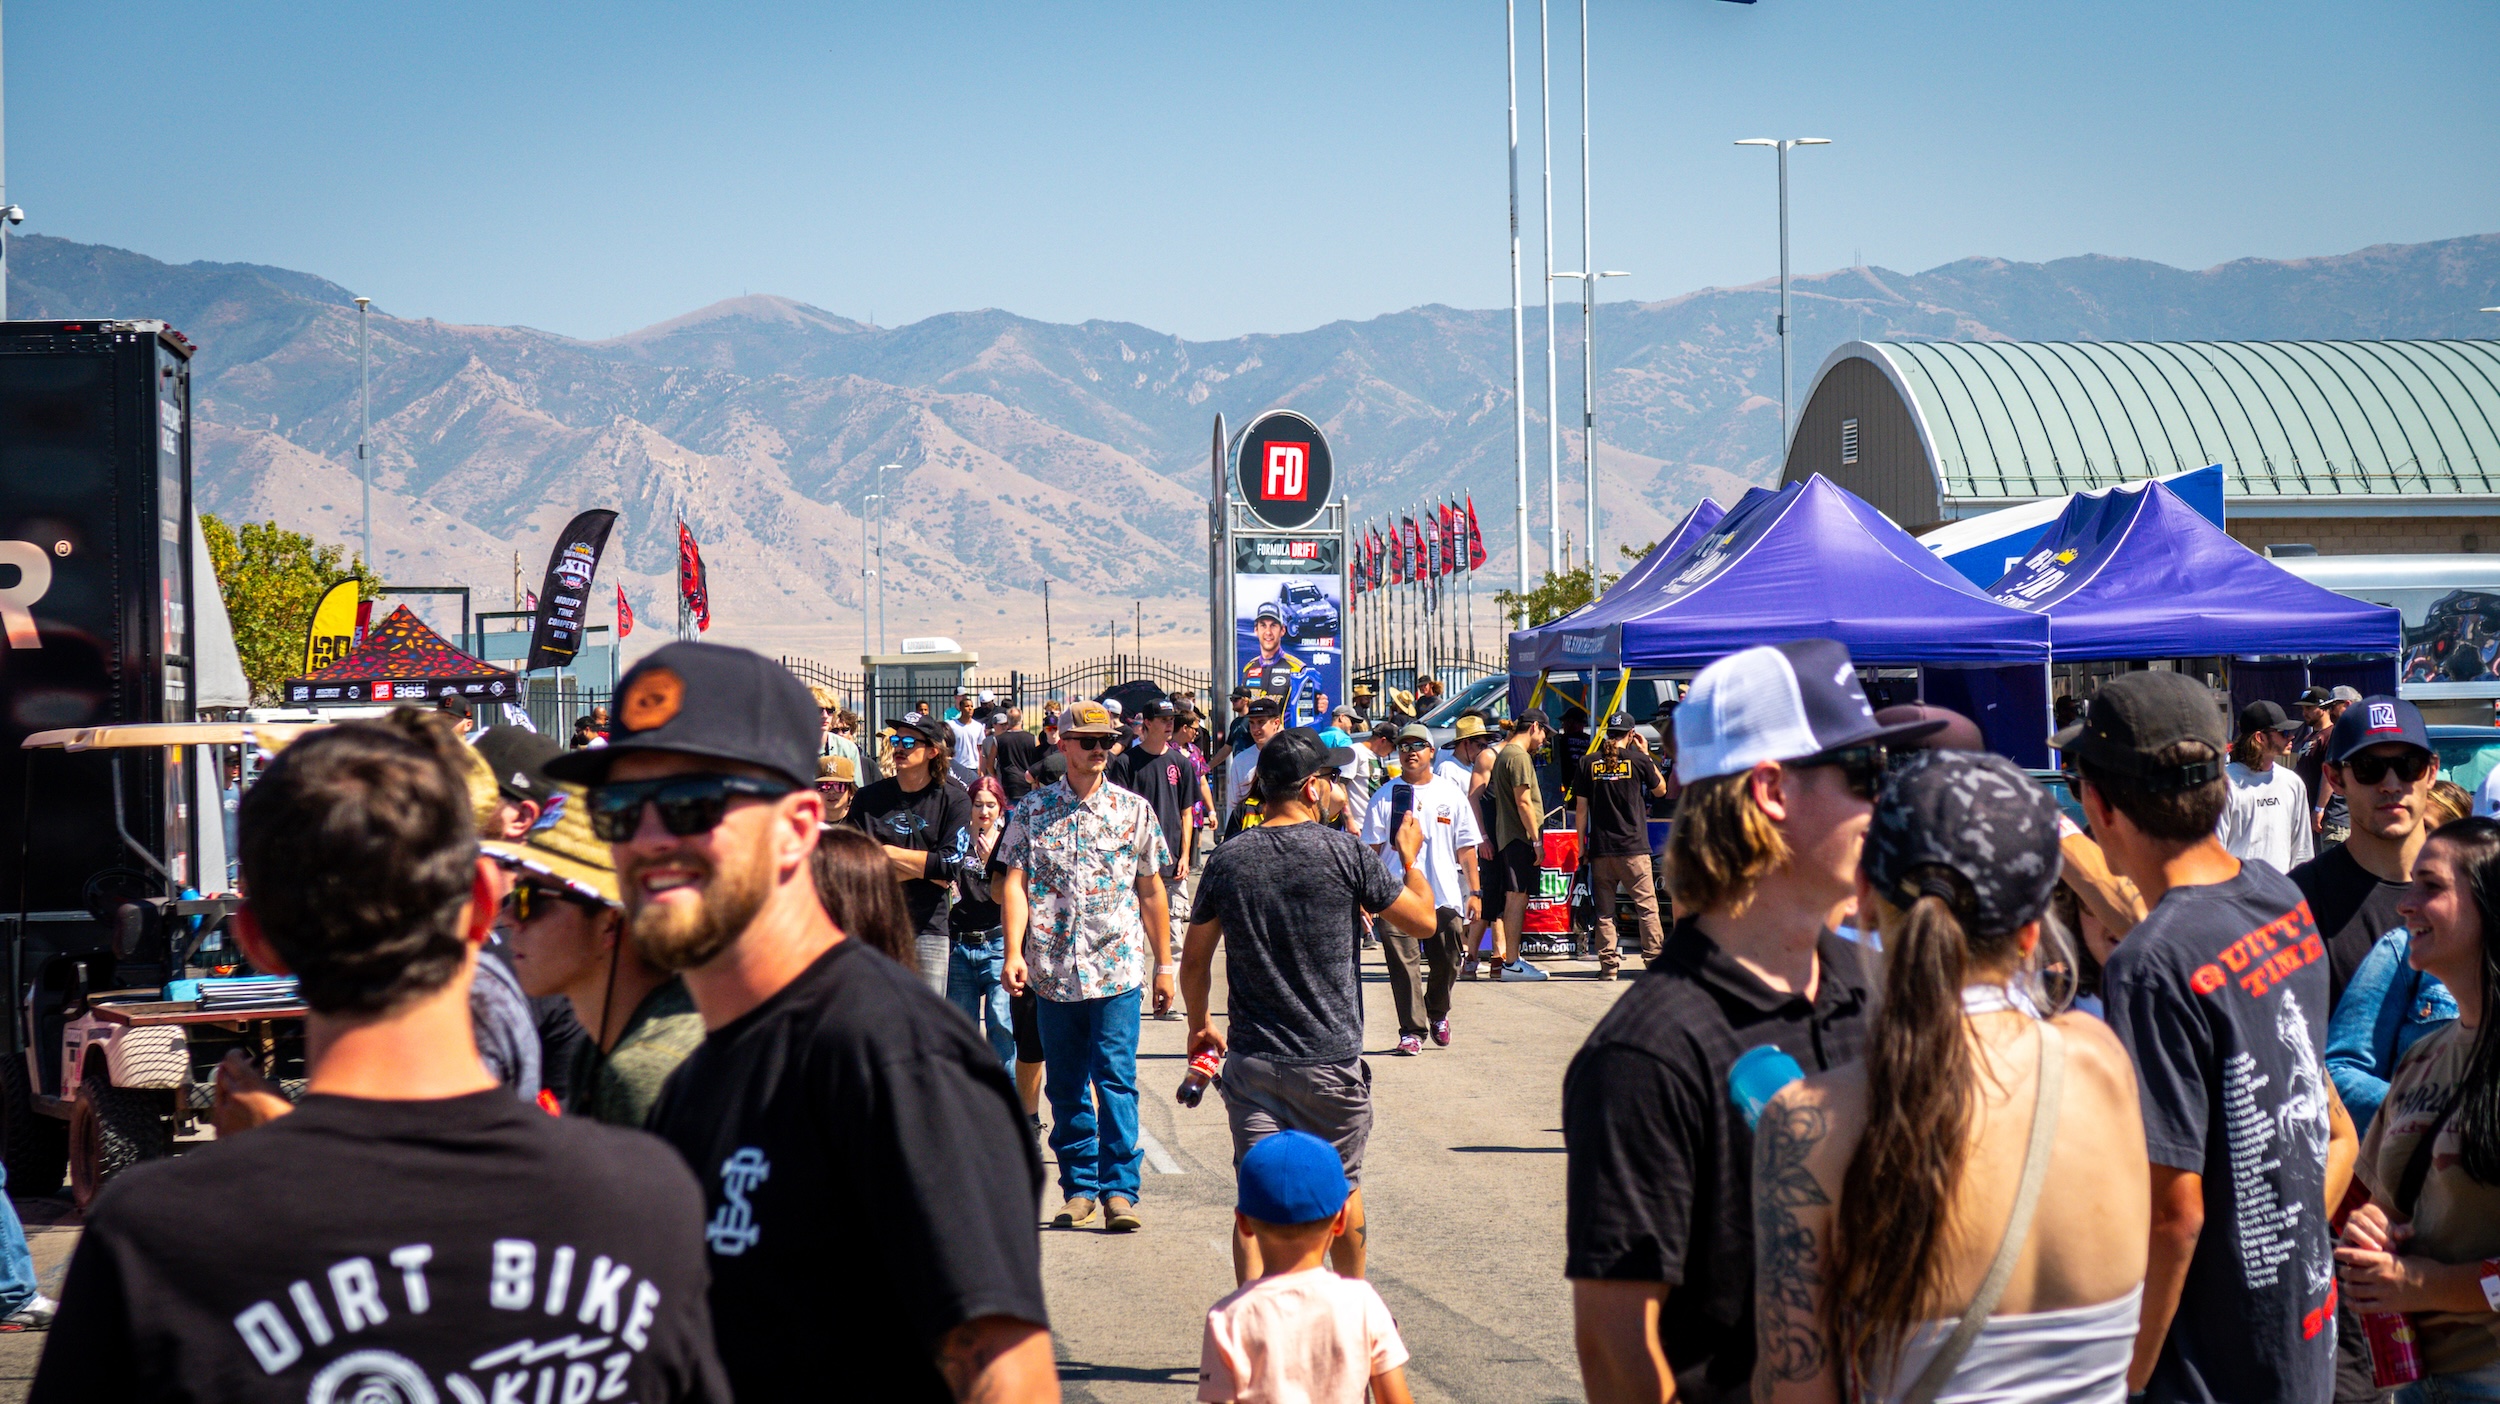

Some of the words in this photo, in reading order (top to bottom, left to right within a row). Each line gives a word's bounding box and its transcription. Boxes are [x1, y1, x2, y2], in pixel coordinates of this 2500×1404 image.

[1267, 446, 1303, 495] FD
[1257, 543, 1290, 556] FORMULA
[1291, 542, 1317, 557] DRIFT
[554, 595, 581, 608] MODIFY
[557, 607, 574, 618] TUNE
[548, 617, 577, 630] COMPETE
[553, 630, 568, 639] WIN
[1301, 639, 1320, 647] FORMULA
[1320, 638, 1334, 646] DRIFT
[394, 686, 426, 698] 365
[2256, 797, 2280, 808] NASA
[2240, 933, 2323, 998] TIME
[2227, 1117, 2275, 1140] Birmingham
[2228, 1128, 2276, 1149] Washington
[2230, 1143, 2268, 1159] Brooklyn
[2251, 1159, 2281, 1175] Moines
[2249, 1183, 2272, 1196] Louis
[2236, 1191, 2279, 1209] Greenville
[2237, 1202, 2277, 1219] Knoxville
[2237, 1216, 2263, 1228] North
[2263, 1210, 2287, 1222] Little
[2240, 1222, 2284, 1239] Oklahoma
[2240, 1232, 2278, 1249] Oakland
[2242, 1249, 2260, 1260] Los
[2261, 1239, 2296, 1255] Angeles
[2244, 1259, 2262, 1269] Las
[2262, 1252, 2290, 1265] Vegas
[2245, 1266, 2278, 1279] Denver
[2248, 1275, 2279, 1290] Detroit
[234, 1243, 433, 1375] DIRT
[489, 1239, 660, 1352] BIKE
[493, 1353, 632, 1404] KIDZ
